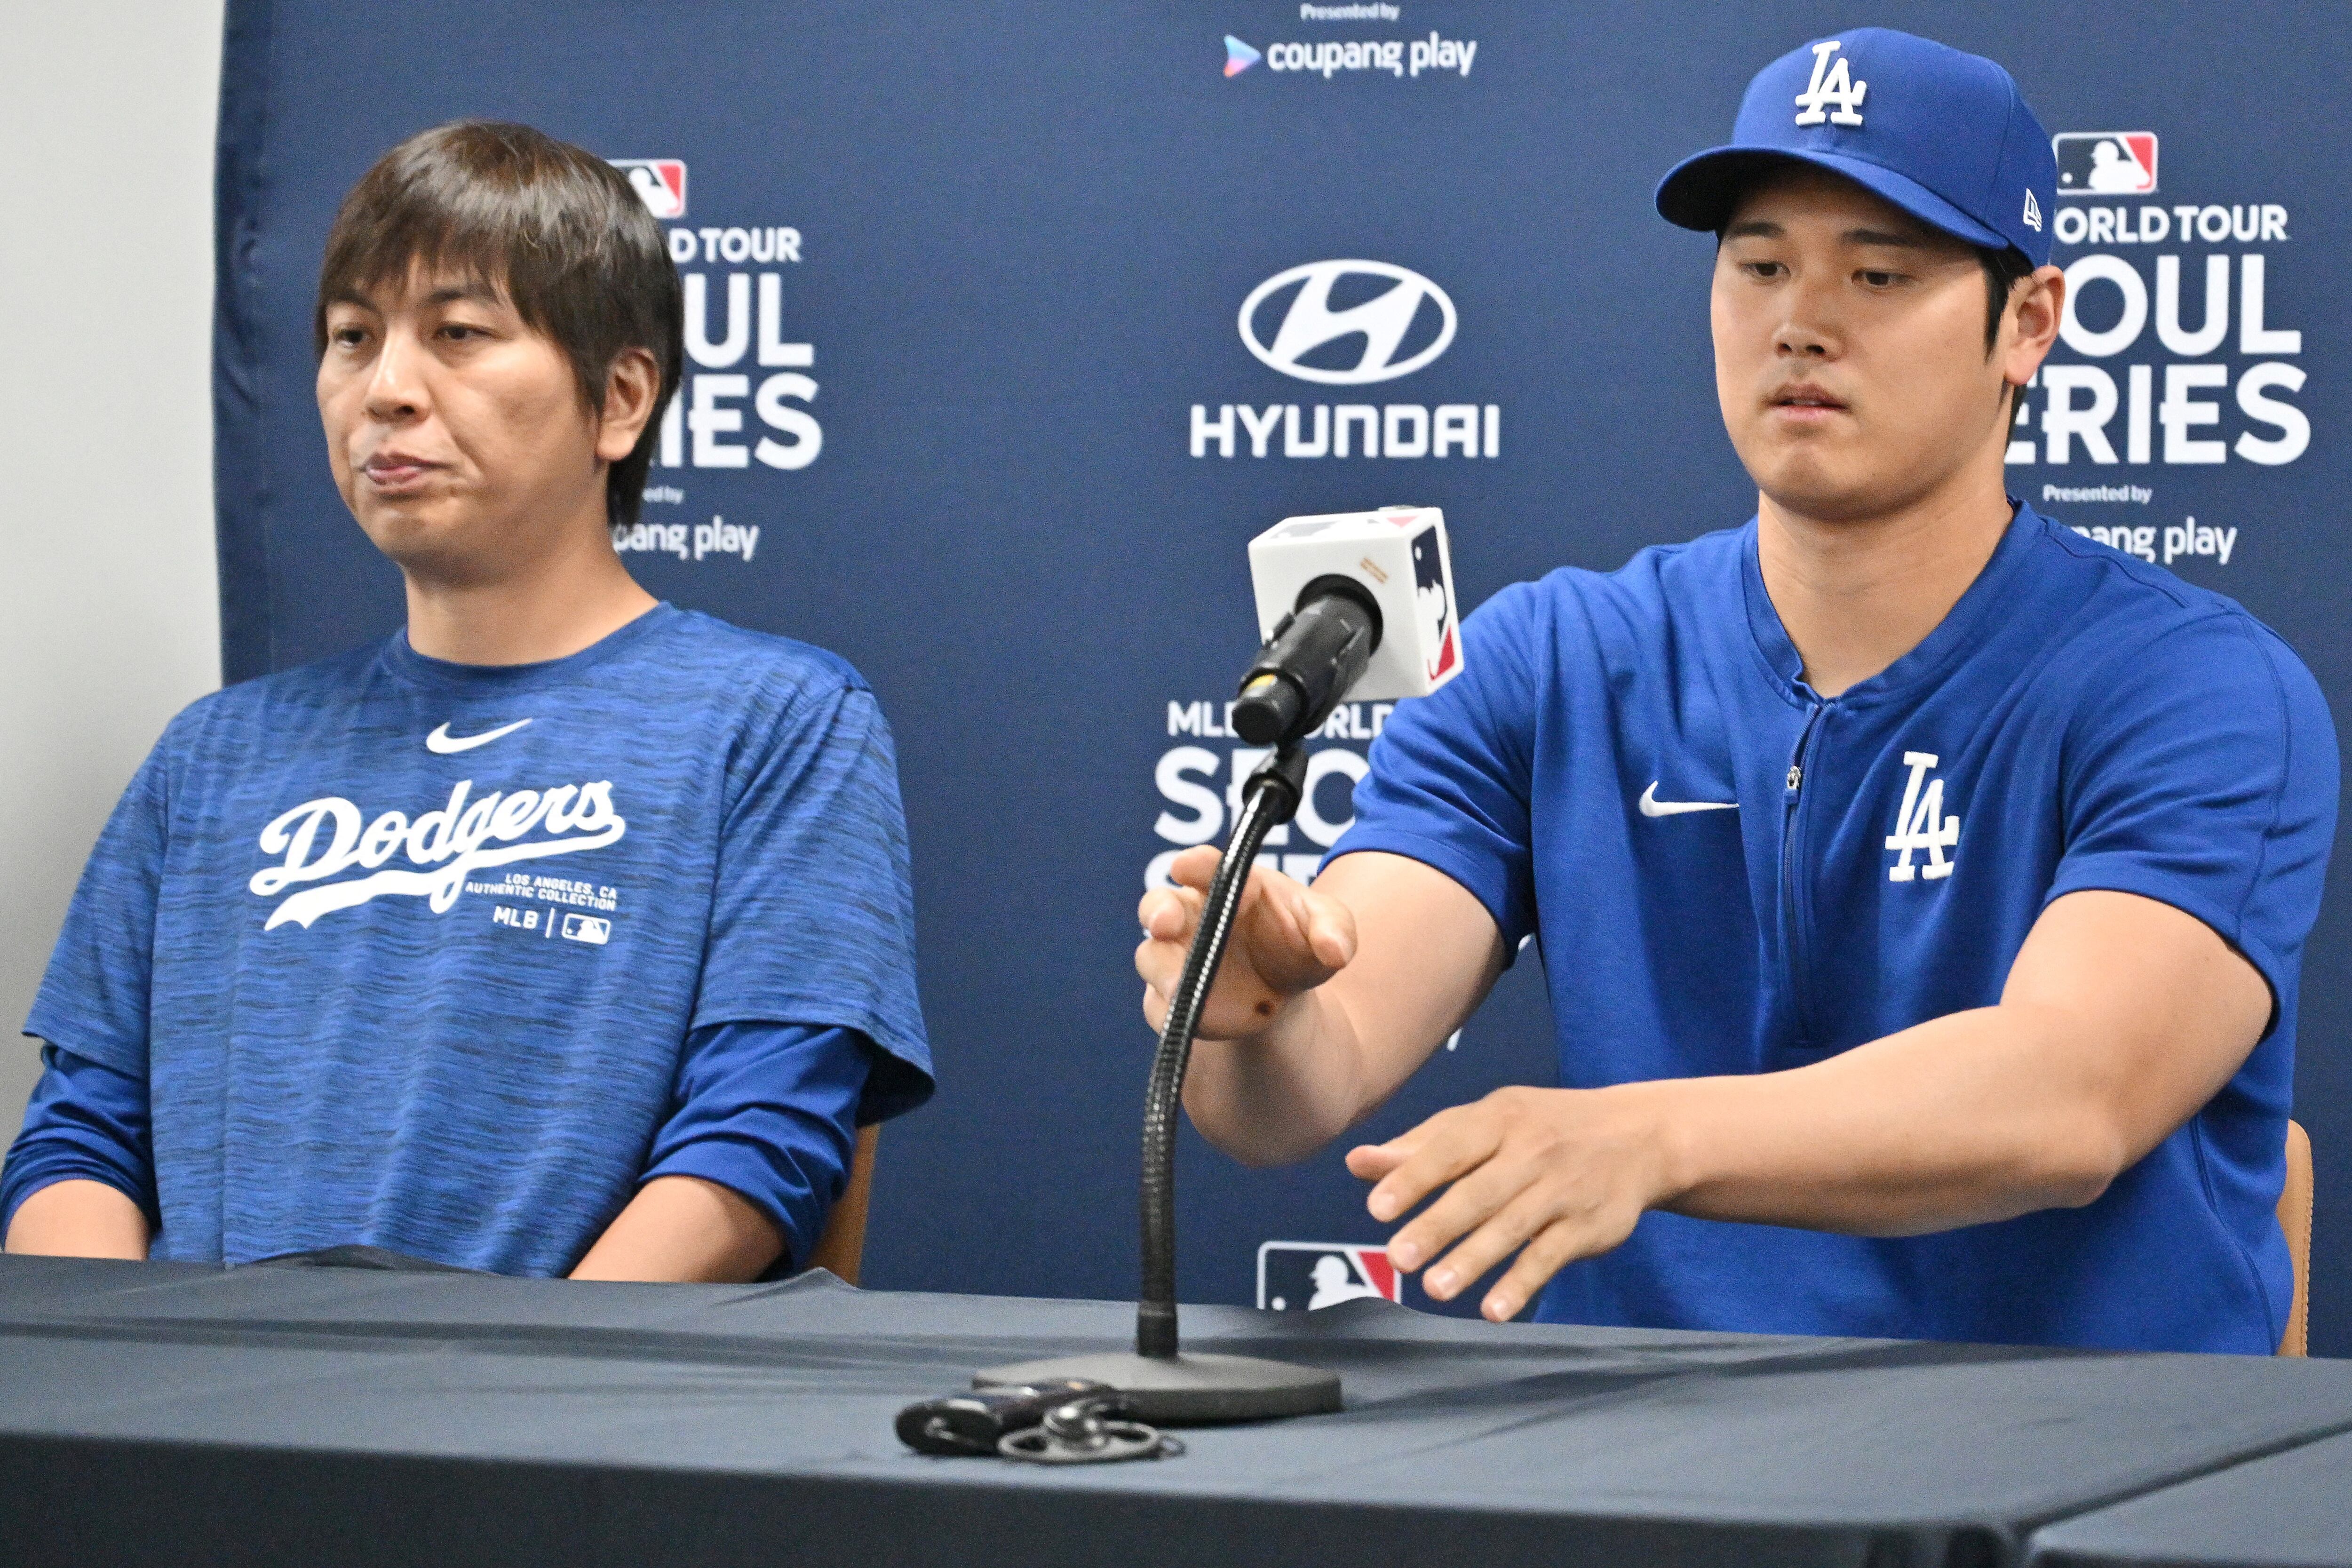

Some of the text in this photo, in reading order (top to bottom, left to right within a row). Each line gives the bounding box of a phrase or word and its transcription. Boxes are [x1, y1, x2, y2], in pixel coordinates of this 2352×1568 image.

[1267, 31, 1478, 79] coupang play
[1795, 40, 1867, 126] LA
[699, 227, 802, 263] TOUR
[2054, 204, 2289, 244] ORLD TOUR
[2058, 253, 2302, 357] OUL
[660, 372, 823, 470] IES
[1190, 404, 1500, 458] HYUNDAI
[2004, 361, 2312, 466] RIES
[2043, 484, 2152, 504] Presented by
[694, 515, 760, 562] play
[2164, 516, 2237, 565] play
[1885, 751, 1960, 882] LA
[249, 779, 627, 931] Dodgers
[465, 881, 616, 911] AUTHENTIC COLLECTION
[505, 873, 617, 900] LOS ANGELES, CA
[493, 906, 539, 930] MLB
